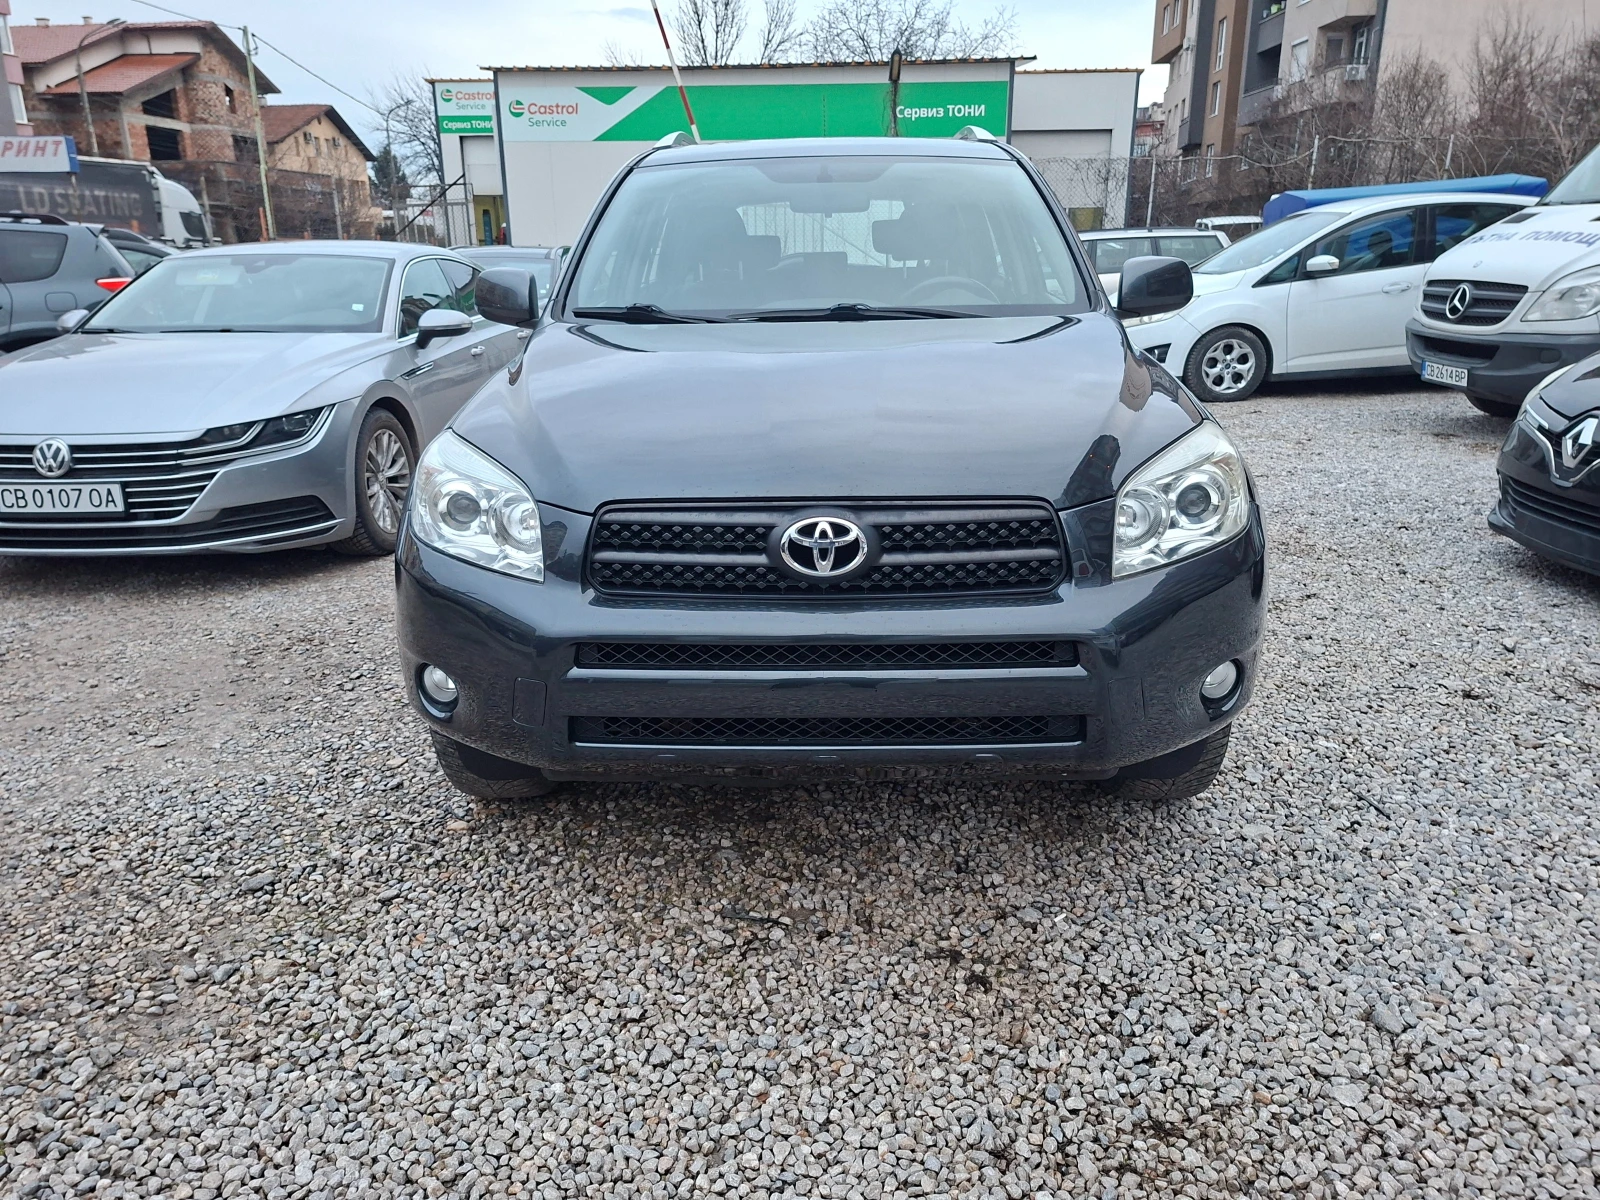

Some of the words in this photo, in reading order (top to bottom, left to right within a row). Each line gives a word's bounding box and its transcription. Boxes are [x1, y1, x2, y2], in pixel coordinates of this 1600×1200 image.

[456, 102, 486, 110] Service
[527, 103, 578, 115] Castrol
[896, 106, 944, 121] Сервиз
[947, 104, 985, 117] ТОНИ
[443, 120, 471, 129] Сервиз
[528, 117, 567, 127] Service
[18, 185, 50, 214] LD
[1436, 364, 1454, 382] 2614
[0, 488, 28, 508] CB
[32, 488, 82, 508] 0107
